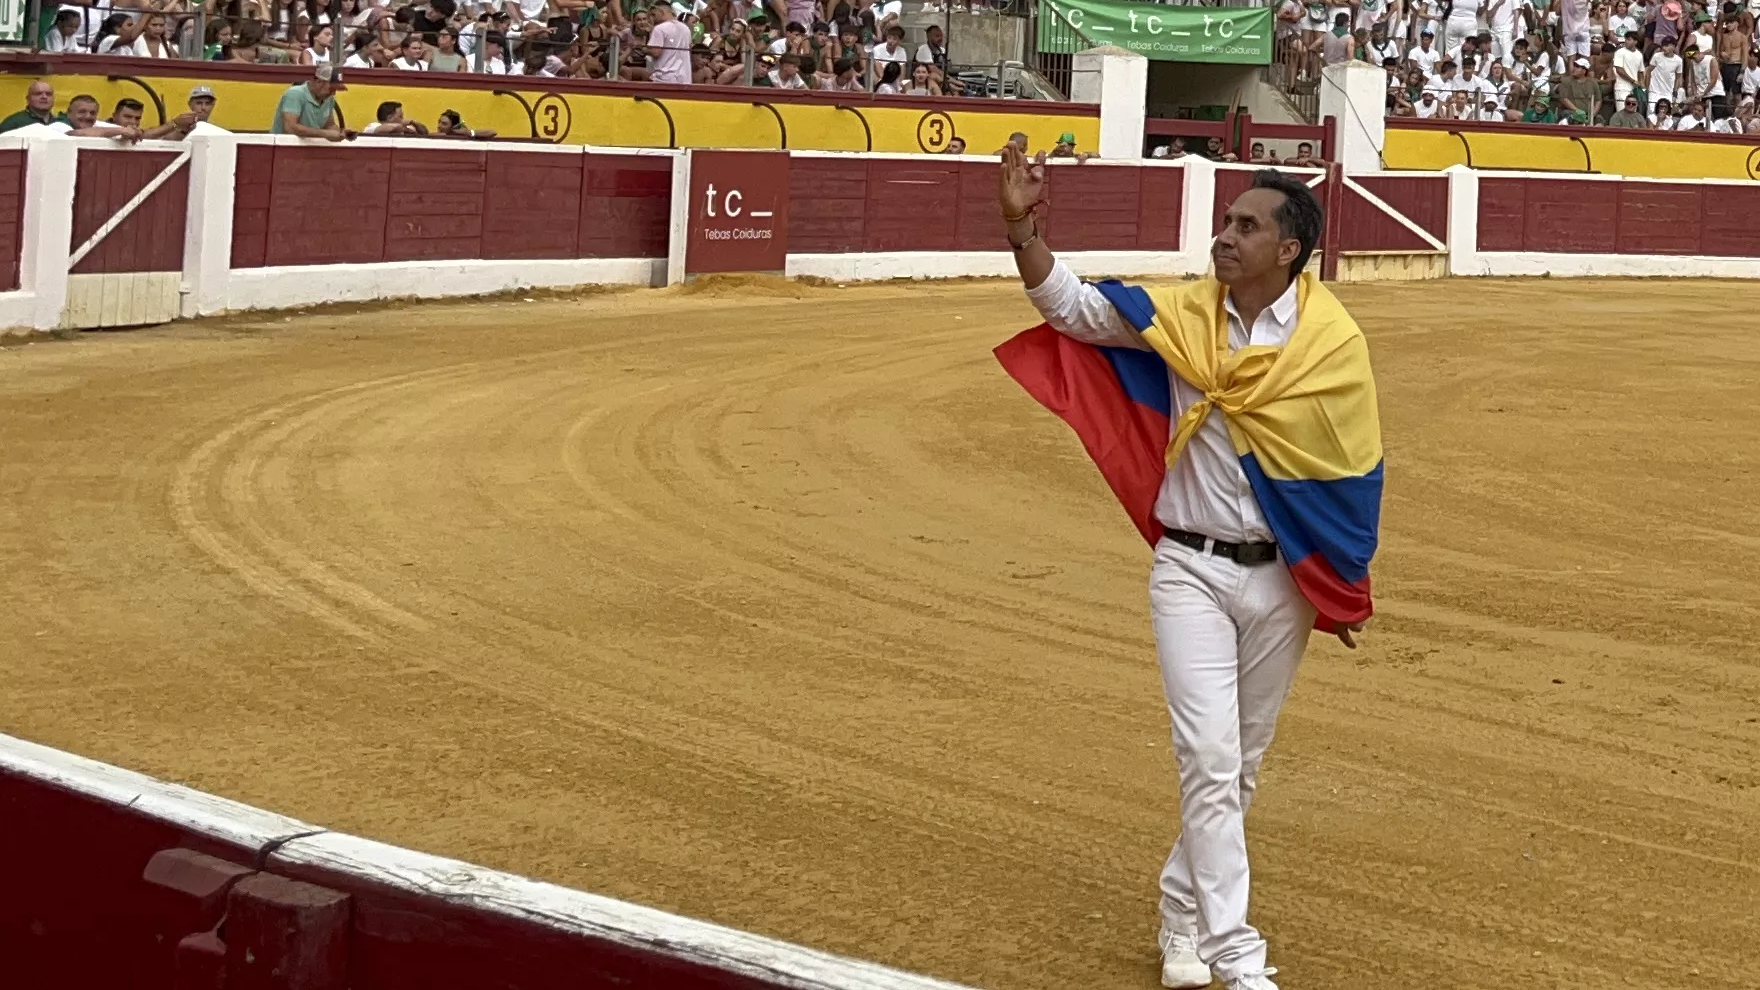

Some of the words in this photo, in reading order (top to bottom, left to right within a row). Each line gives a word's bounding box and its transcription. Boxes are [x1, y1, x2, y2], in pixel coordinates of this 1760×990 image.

[543, 105, 559, 136] 3
[929, 119, 944, 147] 3
[704, 228, 731, 240] Tebas
